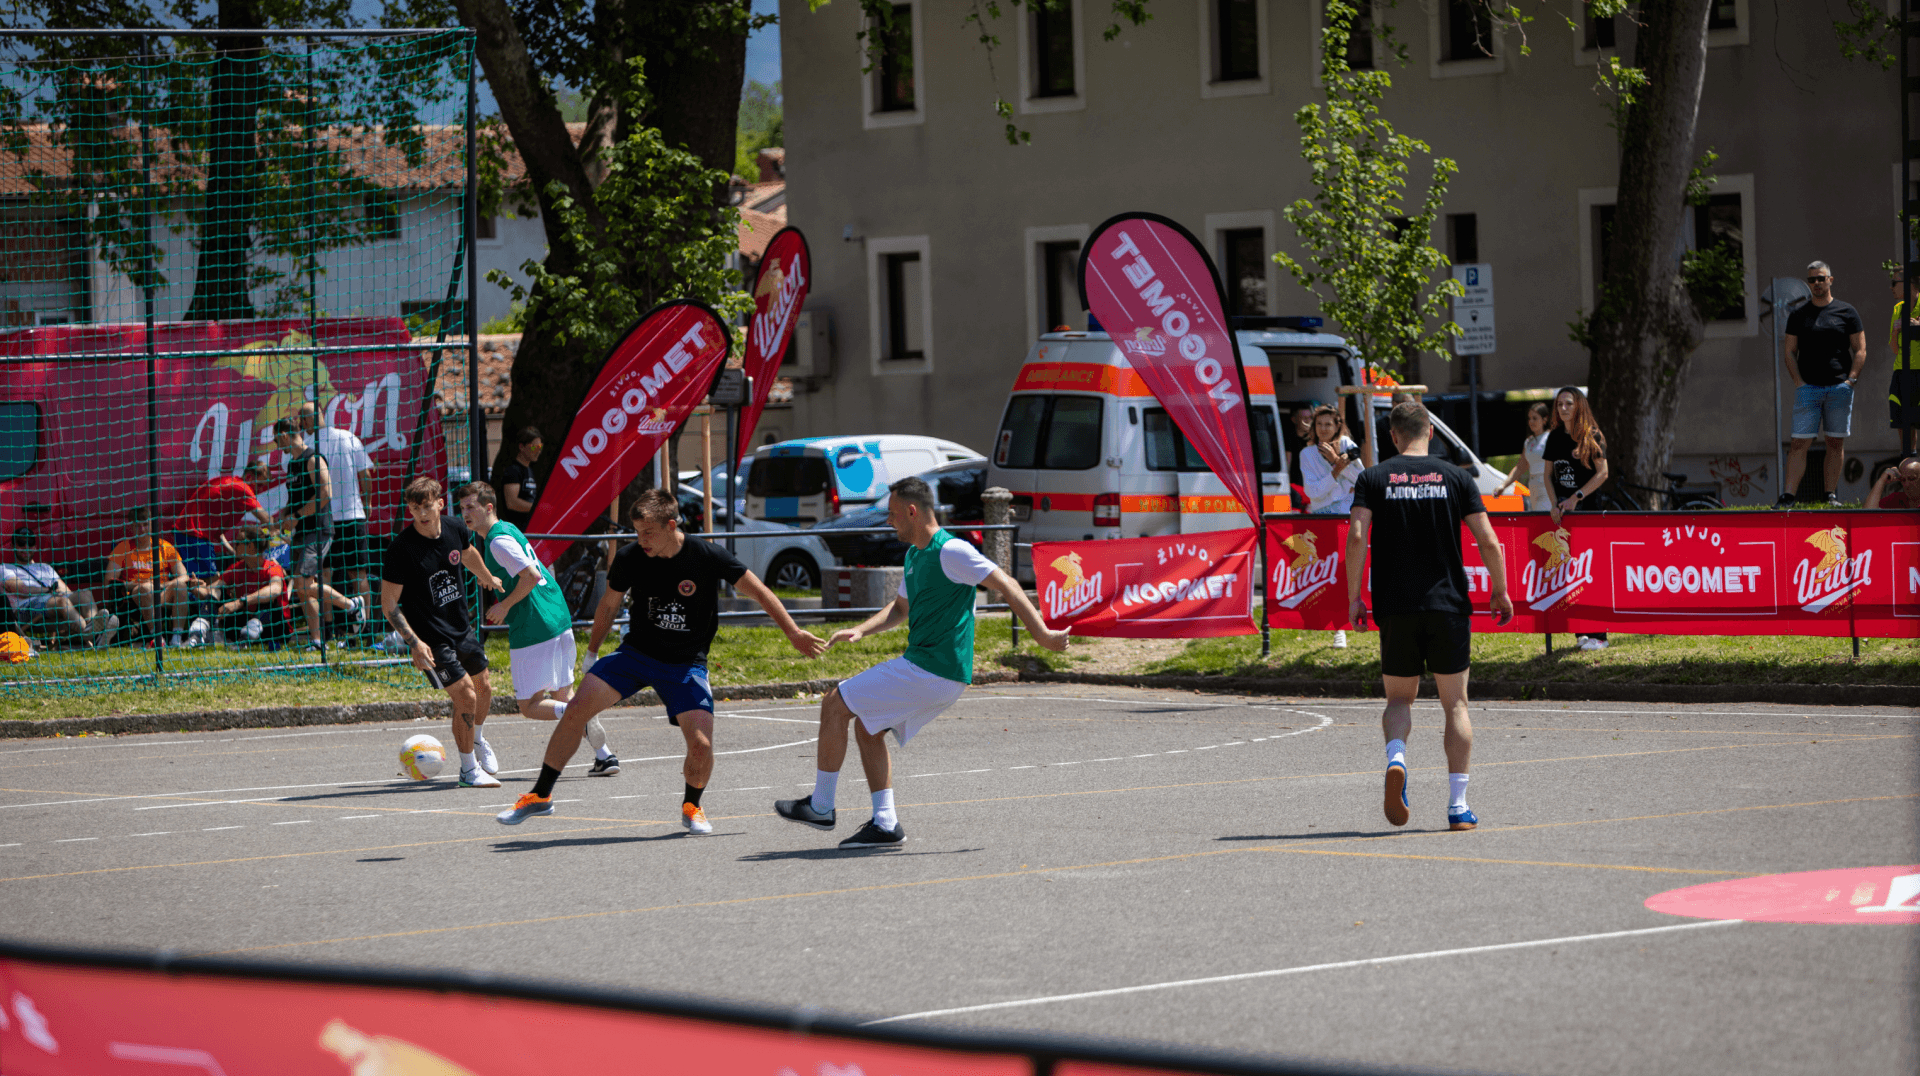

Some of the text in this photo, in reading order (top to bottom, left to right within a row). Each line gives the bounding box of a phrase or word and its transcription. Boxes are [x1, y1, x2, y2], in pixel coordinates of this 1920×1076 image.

[753, 252, 806, 362] Union
[560, 320, 706, 480] NOGOMET
[637, 414, 676, 435] Union
[1386, 483, 1447, 499] AJDOVŠČINA
[1045, 571, 1103, 619] Union
[1123, 573, 1237, 606] NOGOMET
[1272, 551, 1339, 609] Union
[1522, 548, 1594, 612] Union
[1625, 565, 1761, 594] NOGOMET
[1793, 549, 1873, 614] Union
[1824, 588, 1862, 616] PIVOVARNA
